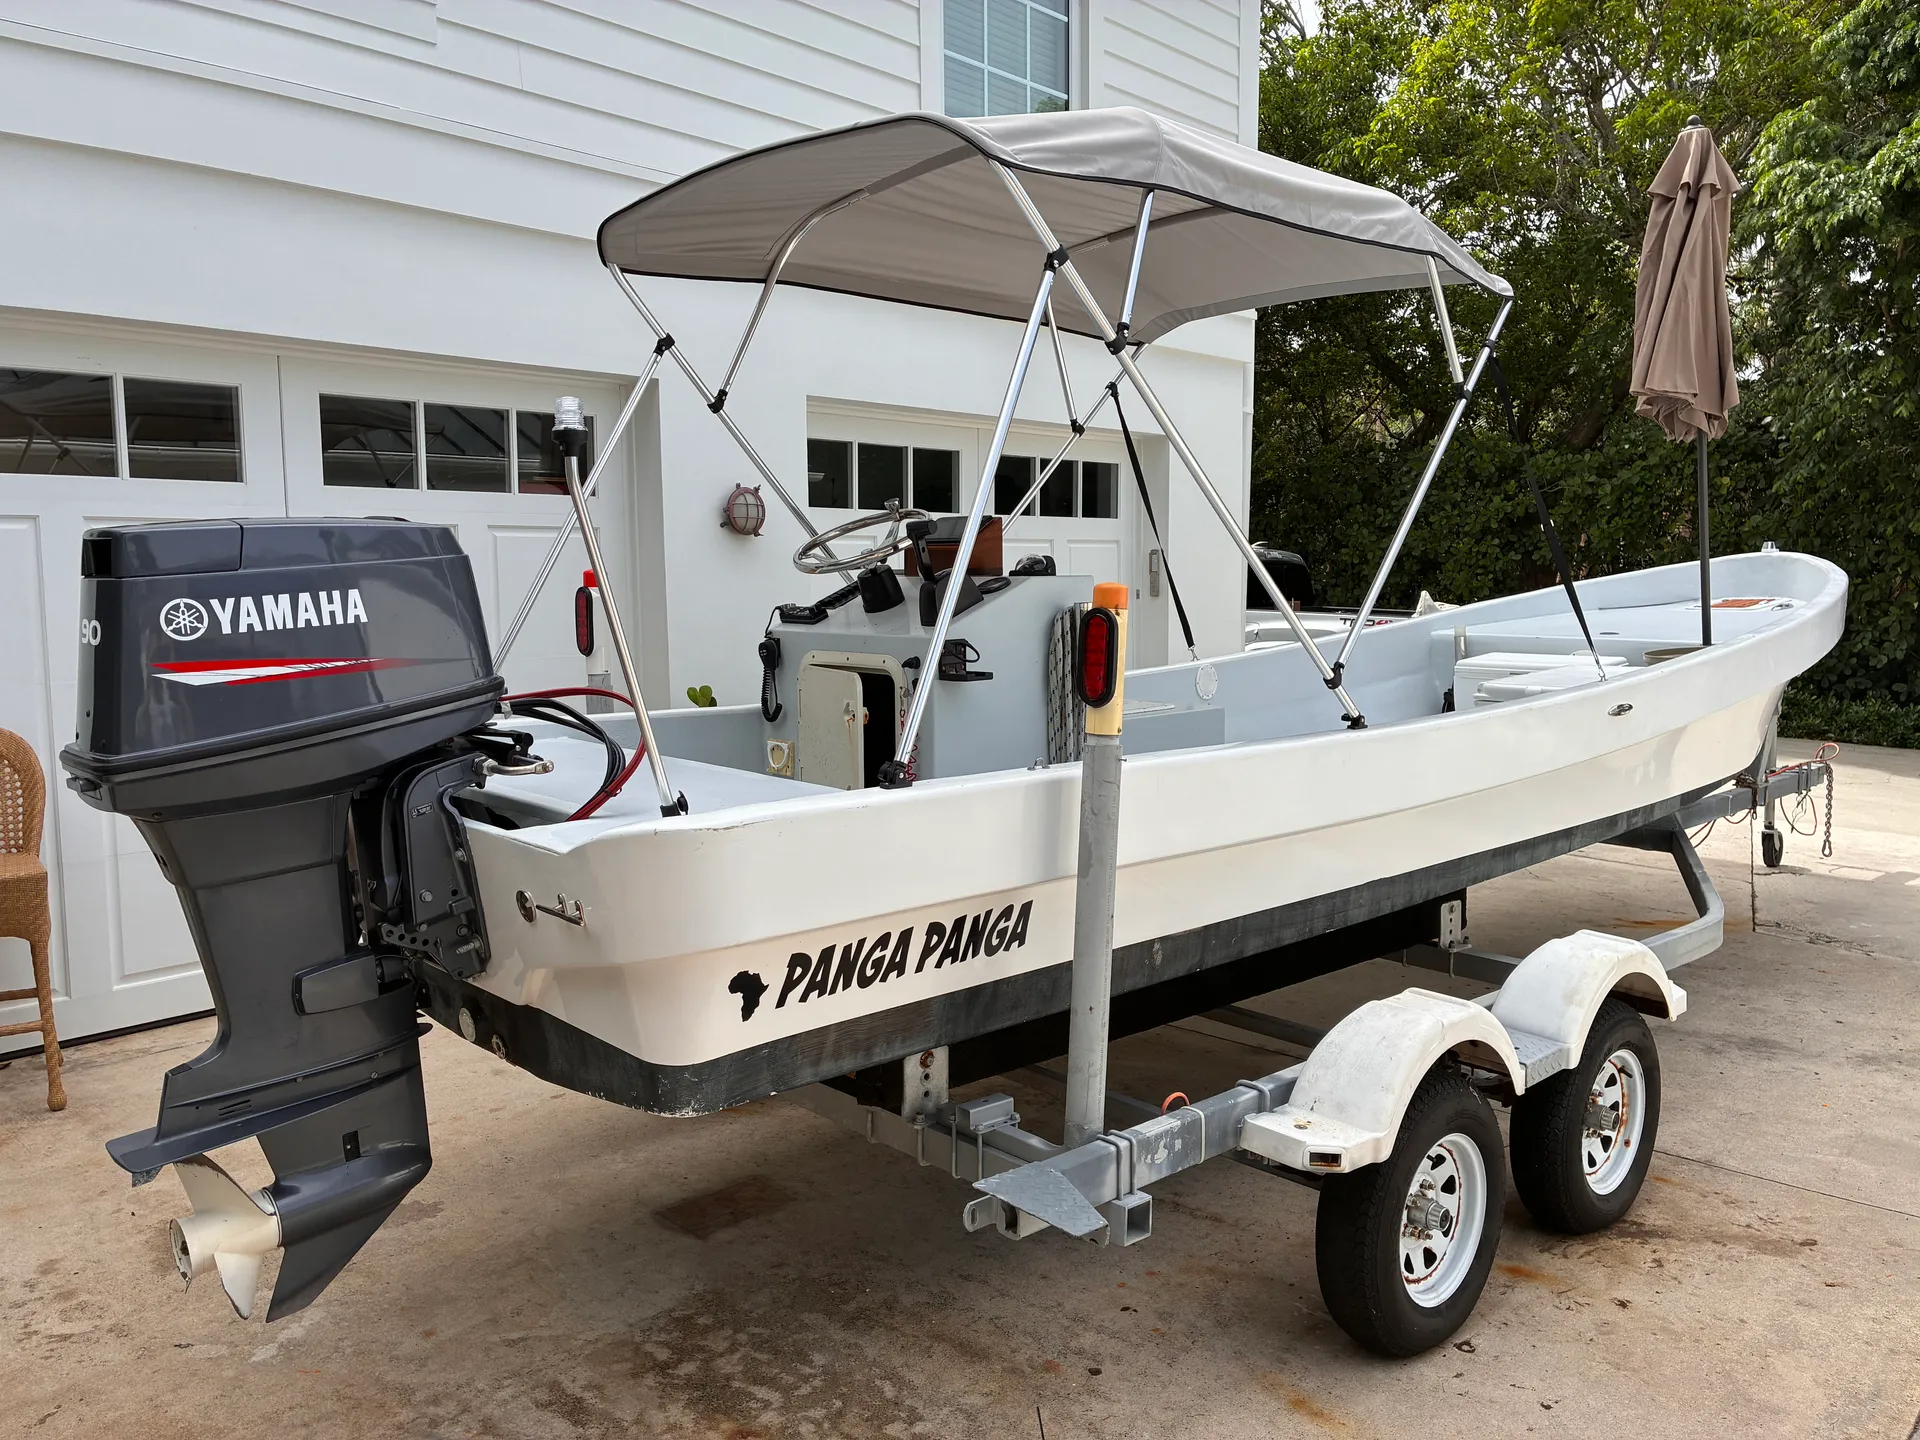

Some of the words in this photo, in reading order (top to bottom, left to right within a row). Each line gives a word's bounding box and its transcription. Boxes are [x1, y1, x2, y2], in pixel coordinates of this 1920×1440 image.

[81, 618, 102, 646] 90
[209, 588, 369, 635] YAMAHA
[774, 926, 914, 1010] PANGA
[914, 899, 1034, 975] PANGA
